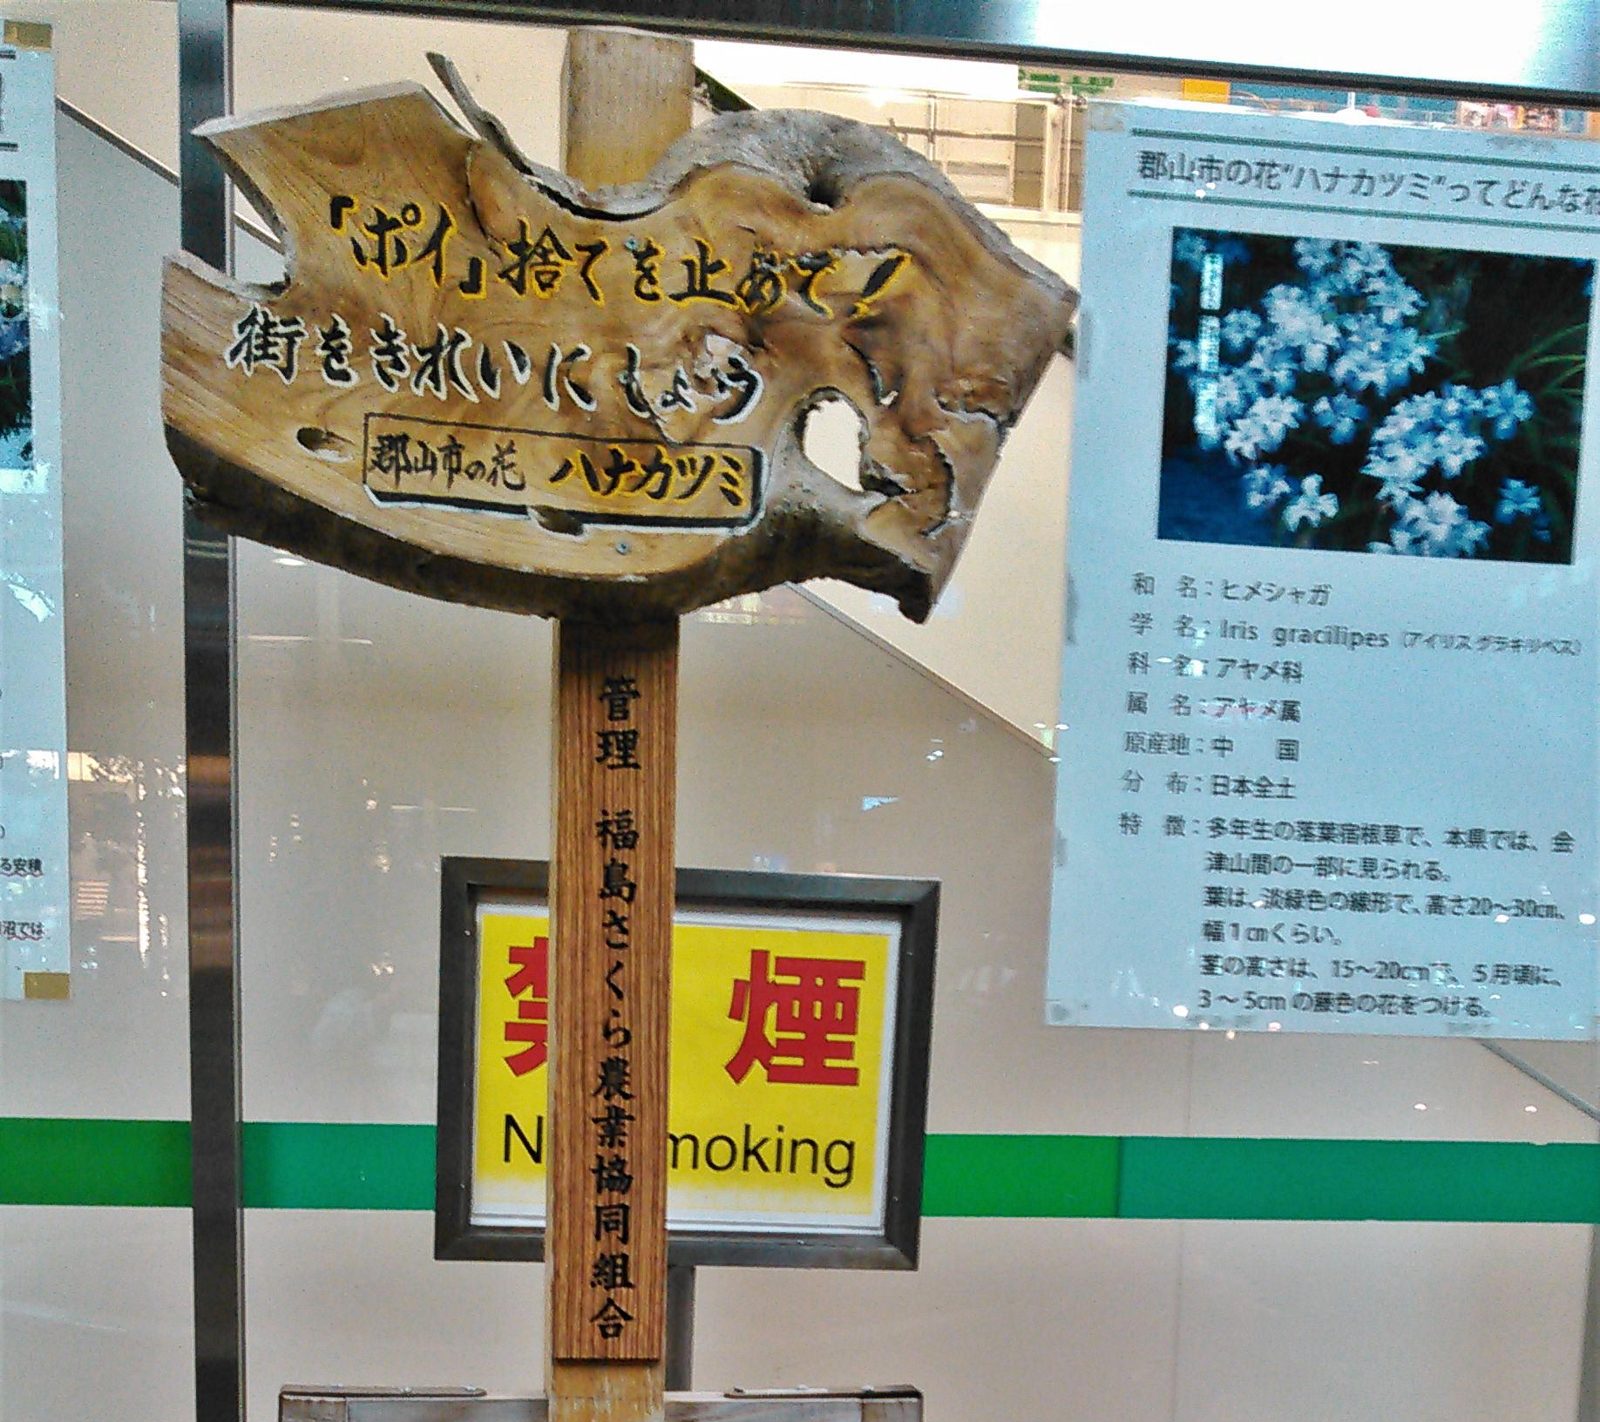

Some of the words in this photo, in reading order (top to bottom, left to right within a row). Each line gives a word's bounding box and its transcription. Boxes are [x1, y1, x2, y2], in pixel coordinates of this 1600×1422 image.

[367, 432, 527, 491] 郡山市の花
[548, 444, 747, 507] ハナカツミ
[596, 676, 641, 771] 管理
[588, 809, 640, 1339] 福島さくら農業協同組合
[503, 1113, 543, 1164] N
[666, 1124, 855, 1188] moking
